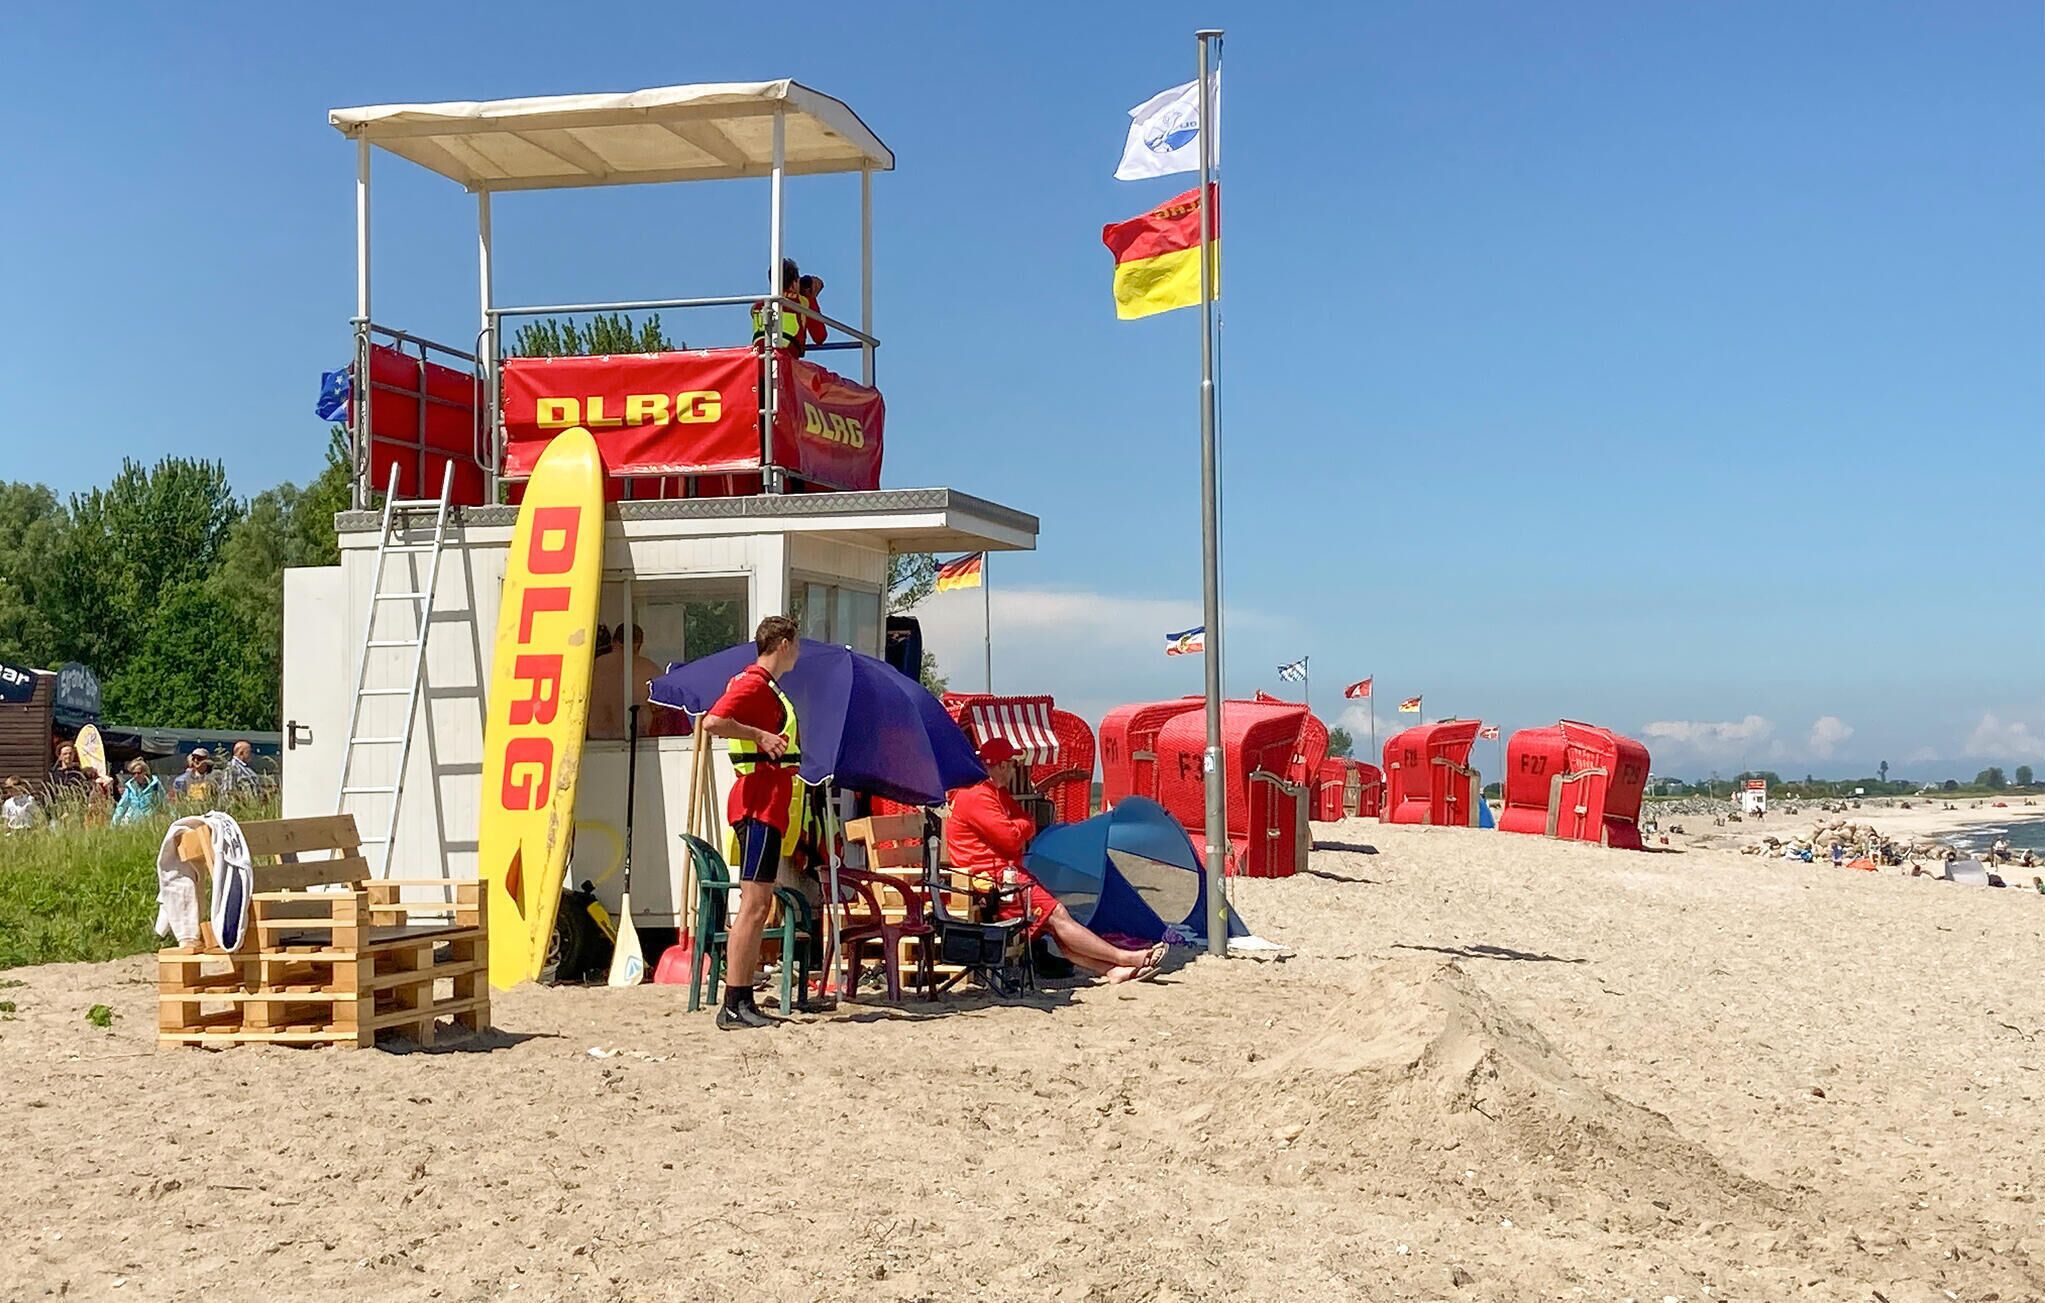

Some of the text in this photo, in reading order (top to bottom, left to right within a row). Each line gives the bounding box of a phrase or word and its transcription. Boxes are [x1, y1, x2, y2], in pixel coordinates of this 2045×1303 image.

[537, 391, 721, 429] DLRG
[804, 401, 865, 448] DLRG
[500, 506, 582, 811] DLRG
[1521, 753, 1548, 776] F27
